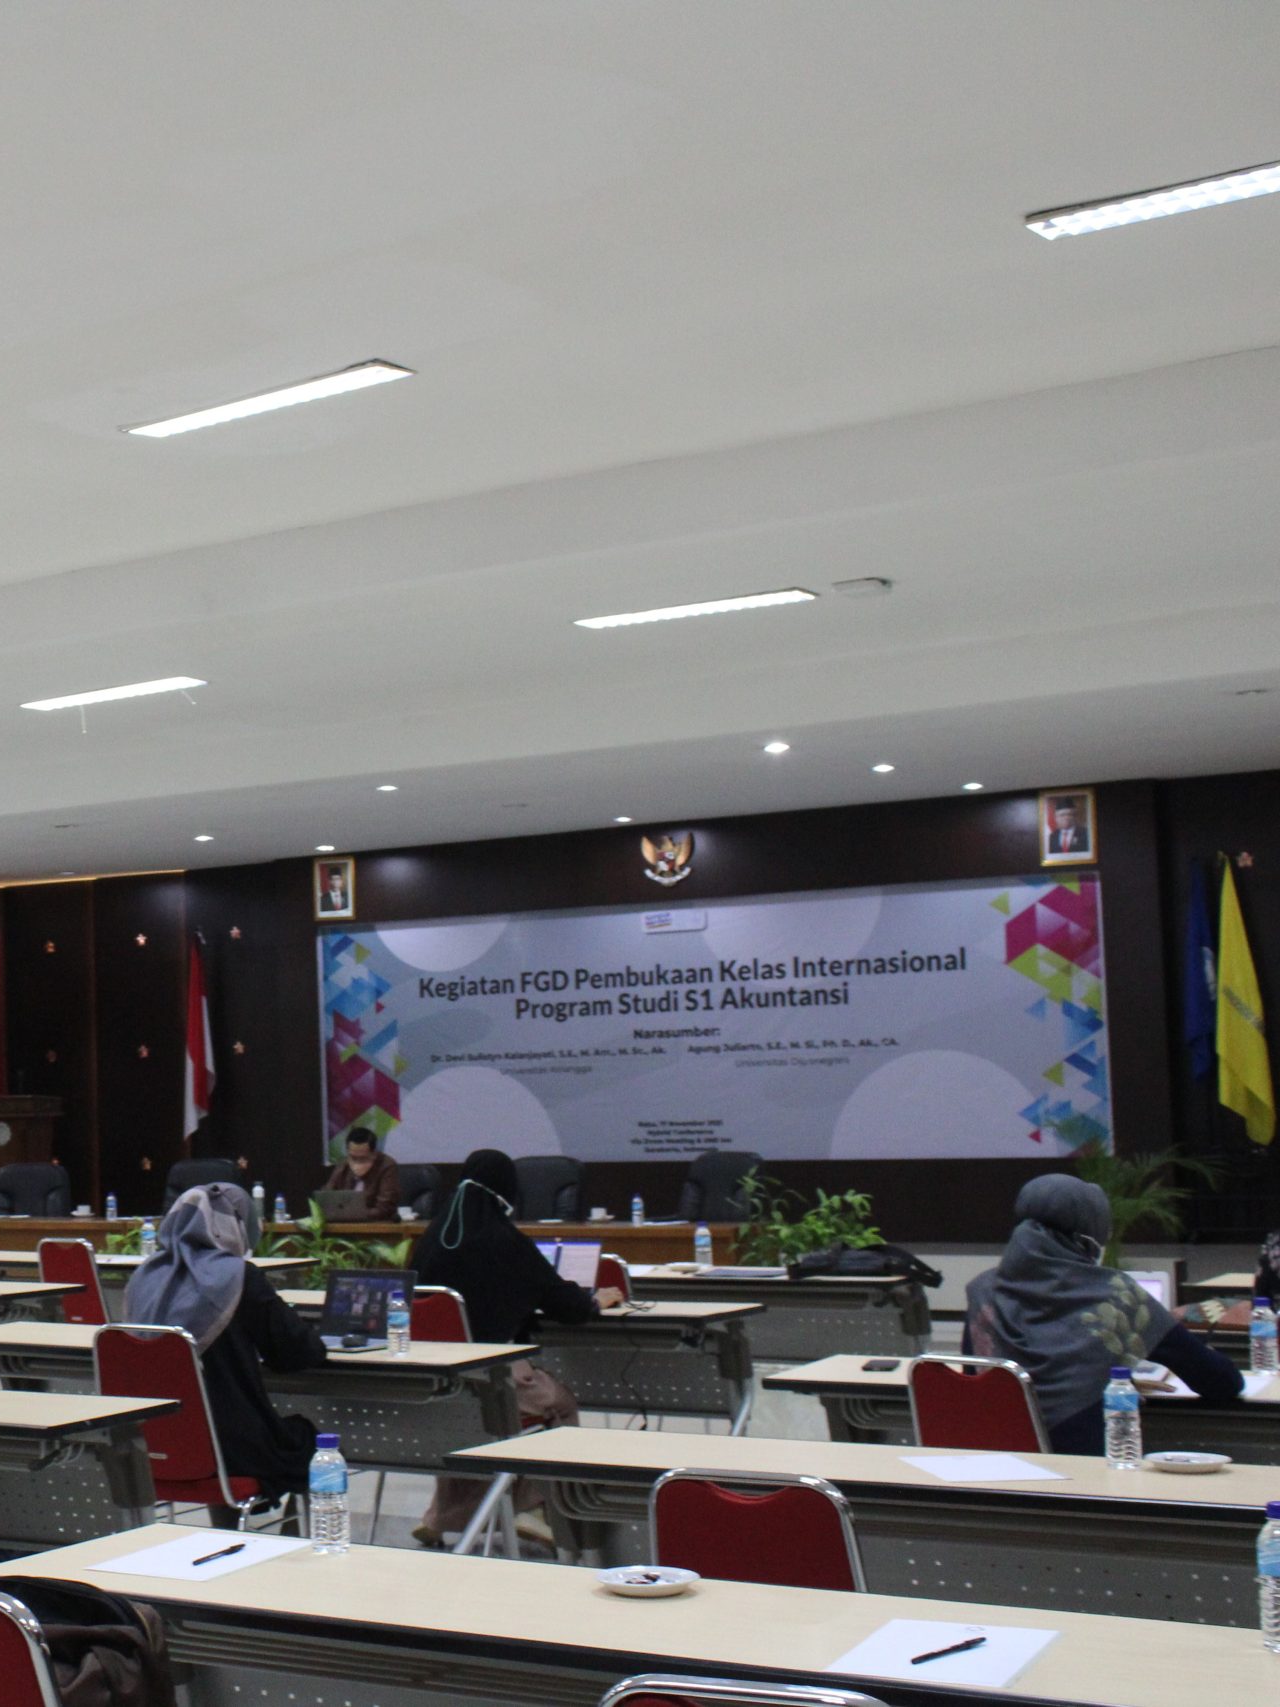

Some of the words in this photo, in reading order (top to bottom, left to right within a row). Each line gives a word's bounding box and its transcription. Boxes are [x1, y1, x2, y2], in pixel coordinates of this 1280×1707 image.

[419, 976, 514, 1001] Kegiatan
[520, 970, 569, 993] FGD
[575, 963, 712, 990] Pembukaan
[719, 958, 786, 982] Kelas
[793, 947, 966, 978] Internasional
[516, 998, 612, 1023] Program
[618, 990, 679, 1014] Studi
[685, 989, 714, 1012] S1
[720, 982, 849, 1010] Akuntansi
